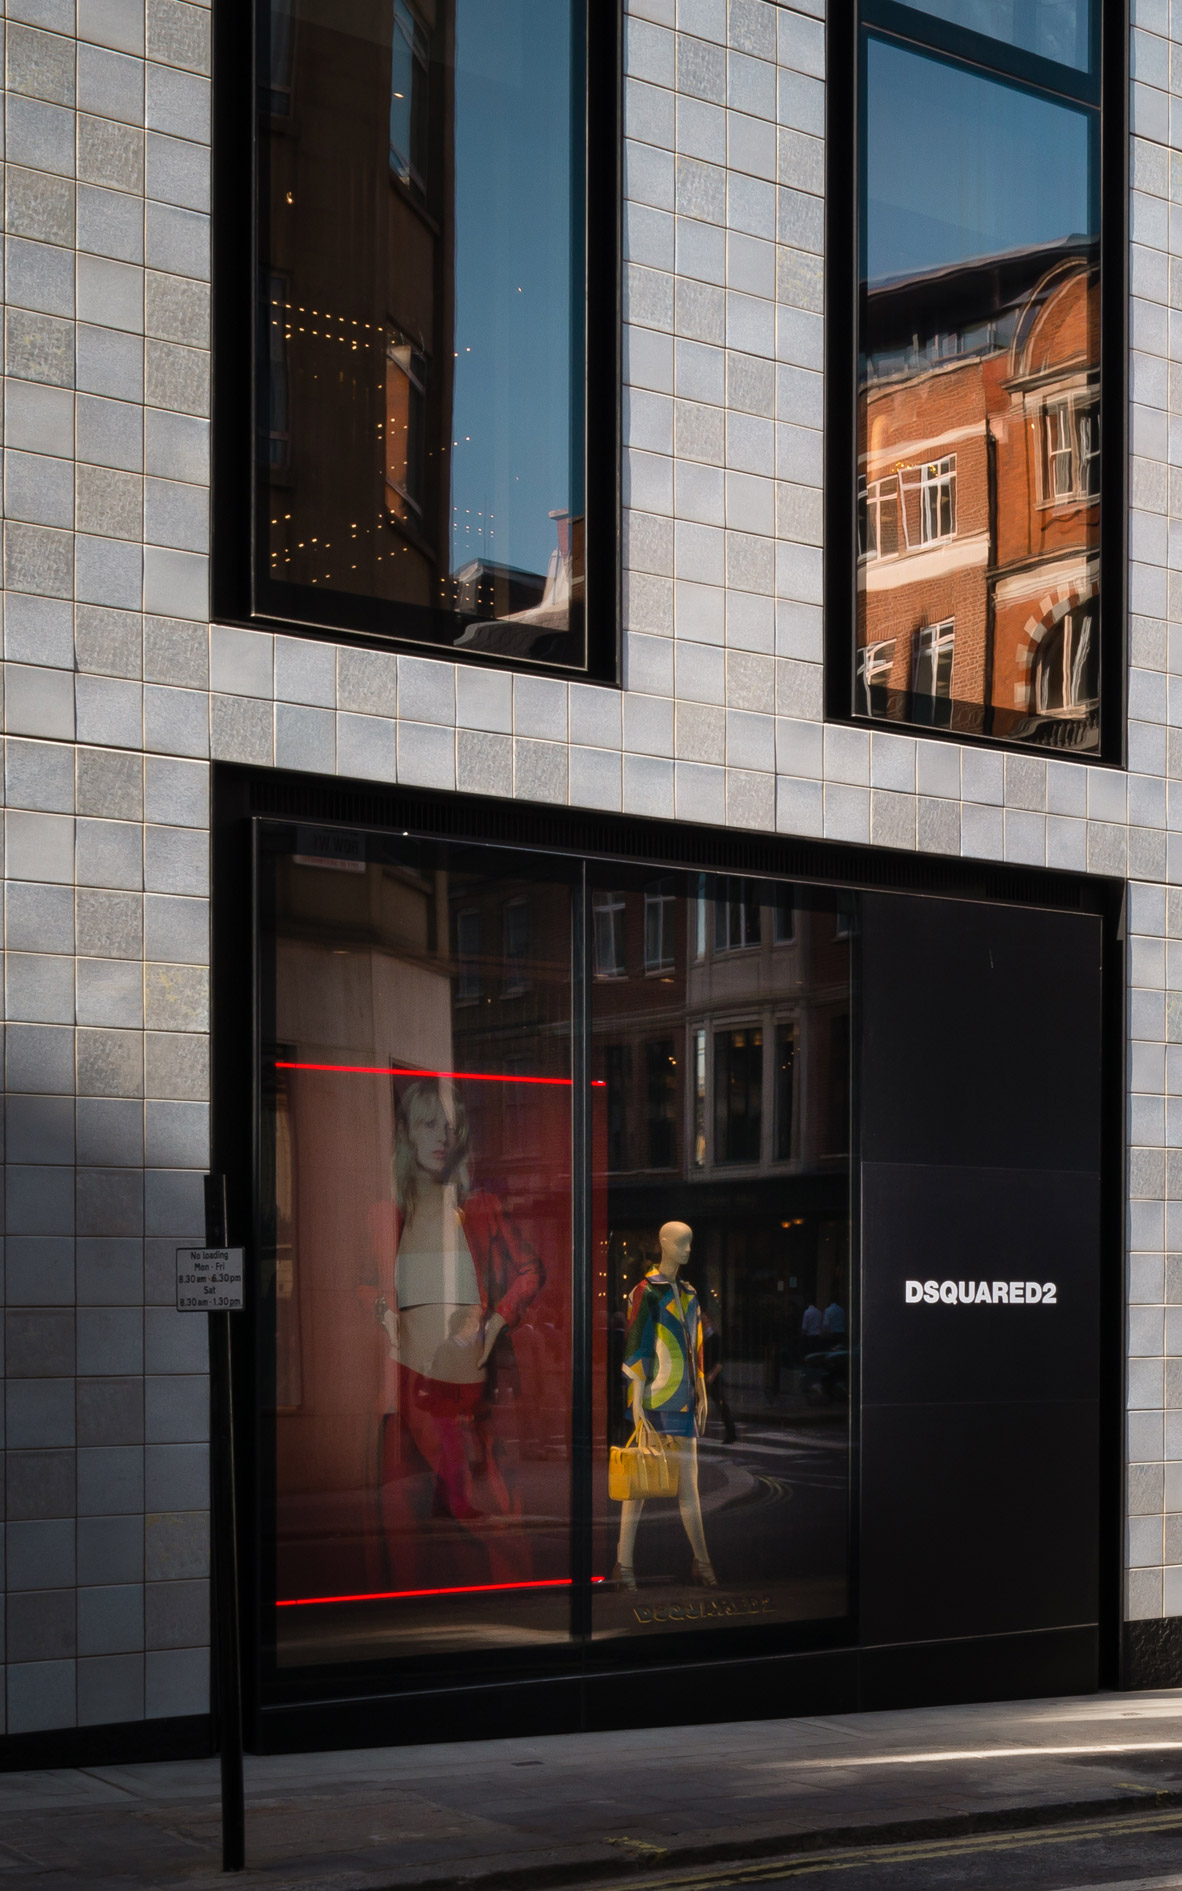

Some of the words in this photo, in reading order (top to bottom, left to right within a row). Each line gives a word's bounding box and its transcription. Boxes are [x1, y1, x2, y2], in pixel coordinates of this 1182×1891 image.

[191, 1251, 200, 1260] No
[203, 1251, 229, 1261] loading
[194, 1263, 209, 1271] Mon
[215, 1262, 225, 1270] Fri
[179, 1274, 196, 1284] 8.30
[230, 1275, 241, 1283] pm
[204, 1286, 216, 1294] Sat
[905, 1280, 1058, 1306] DSQUARED2
[180, 1297, 197, 1307] 8.30
[213, 1296, 229, 1306] 1.30
[230, 1299, 240, 1307] pm
